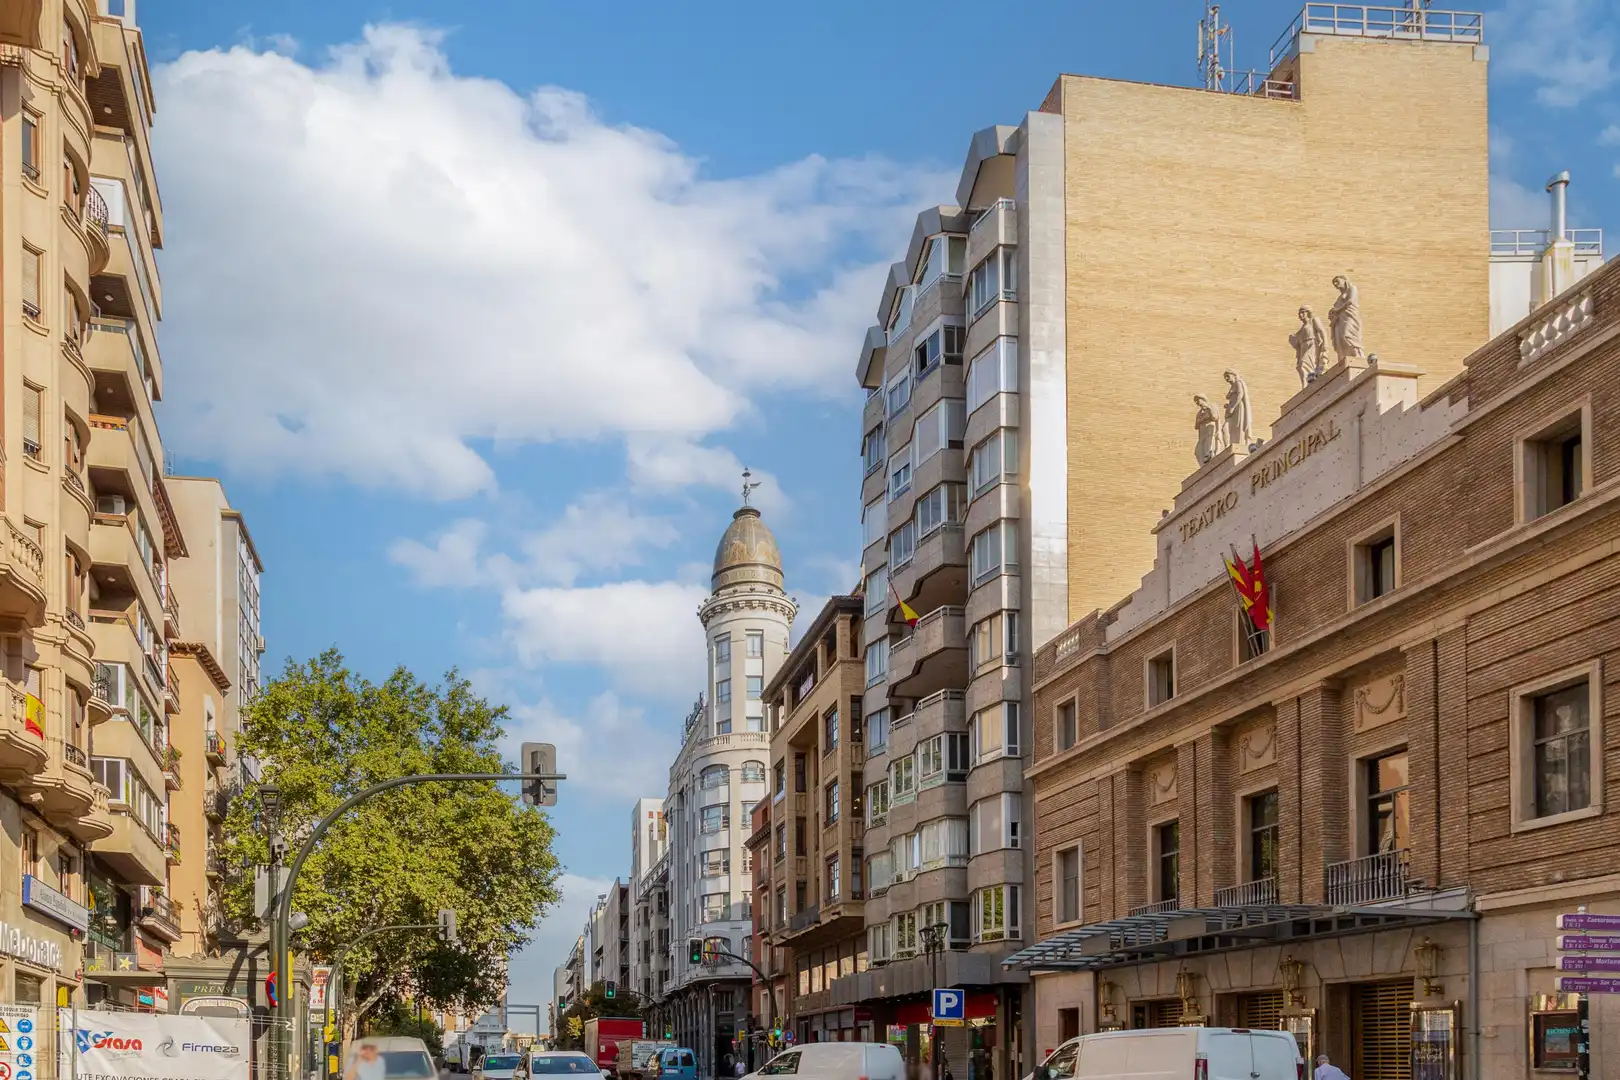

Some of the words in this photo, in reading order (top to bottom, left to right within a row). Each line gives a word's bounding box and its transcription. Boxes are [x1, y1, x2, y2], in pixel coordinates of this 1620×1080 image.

[1179, 491, 1239, 544] TEATRO
[1249, 420, 1341, 495] PRINCIPAL
[193, 985, 238, 993] PRENSA
[940, 992, 958, 1015] P
[182, 1043, 239, 1053] Firmeza
